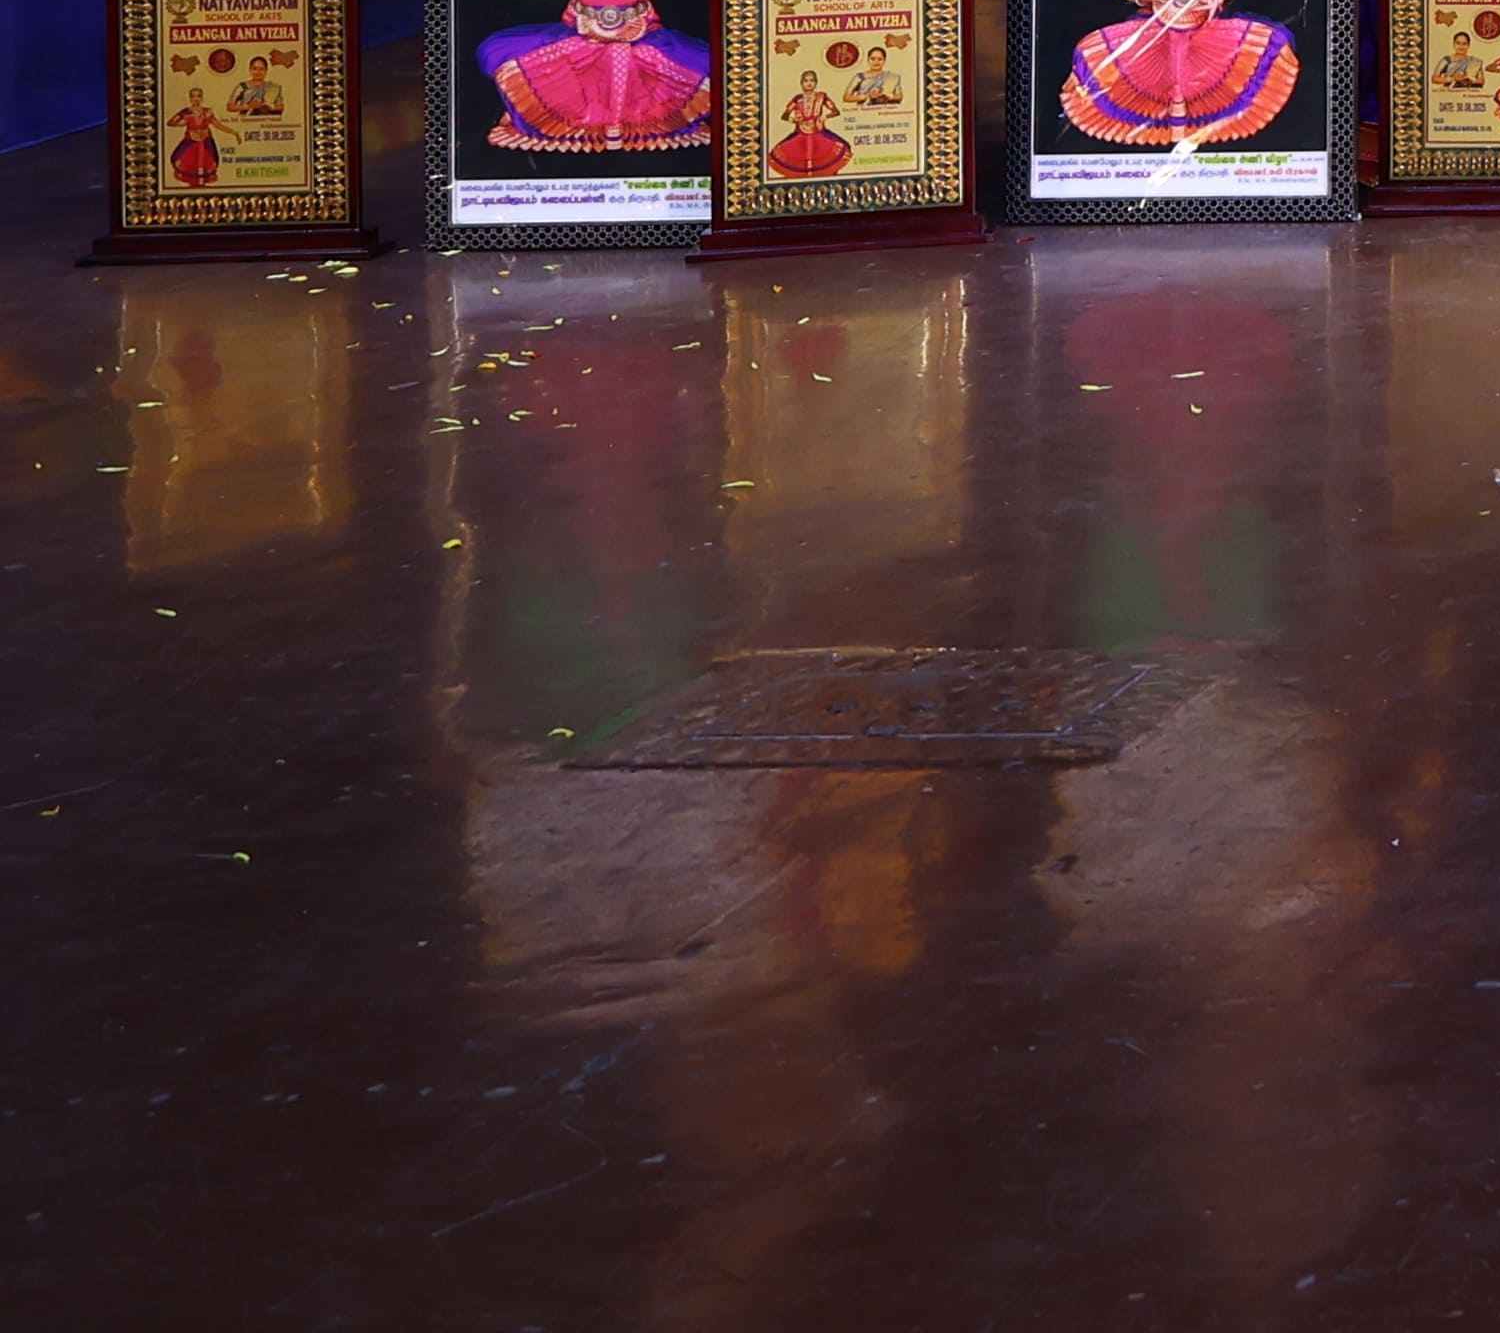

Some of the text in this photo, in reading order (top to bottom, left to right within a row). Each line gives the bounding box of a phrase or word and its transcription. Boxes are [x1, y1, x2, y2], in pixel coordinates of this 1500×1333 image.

[814, 1, 894, 12] SCHOOL OF ARTS
[205, 12, 283, 22] SCHOOL OF ARTS
[777, 14, 909, 33] SALANGAI ANI VIZHA
[172, 25, 297, 41] SALANGAI ANI VIZHA
